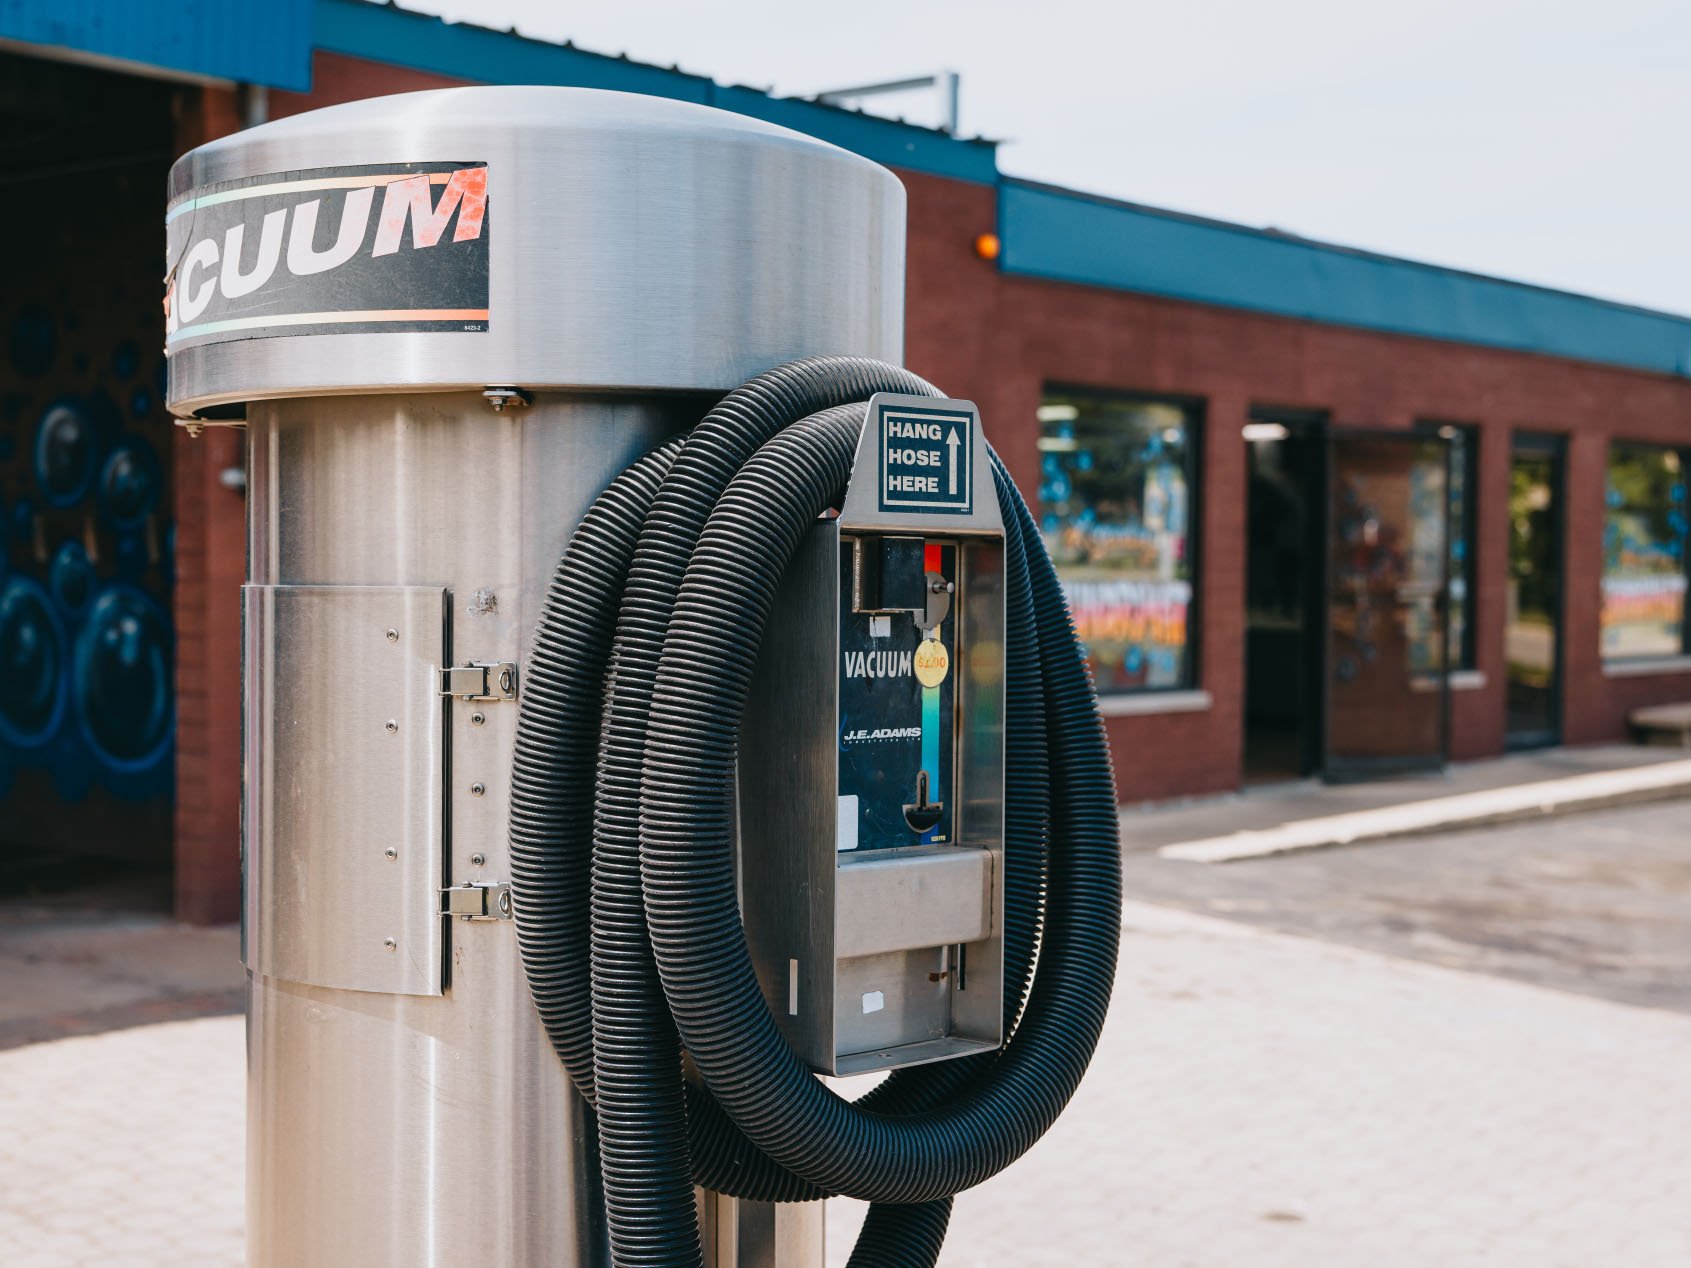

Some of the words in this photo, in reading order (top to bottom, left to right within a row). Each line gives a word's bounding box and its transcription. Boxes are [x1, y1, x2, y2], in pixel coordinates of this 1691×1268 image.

[888, 421, 942, 440] HANG
[888, 448, 941, 467] HOSE
[888, 475, 939, 493] HERE
[844, 651, 912, 678] VACUUM
